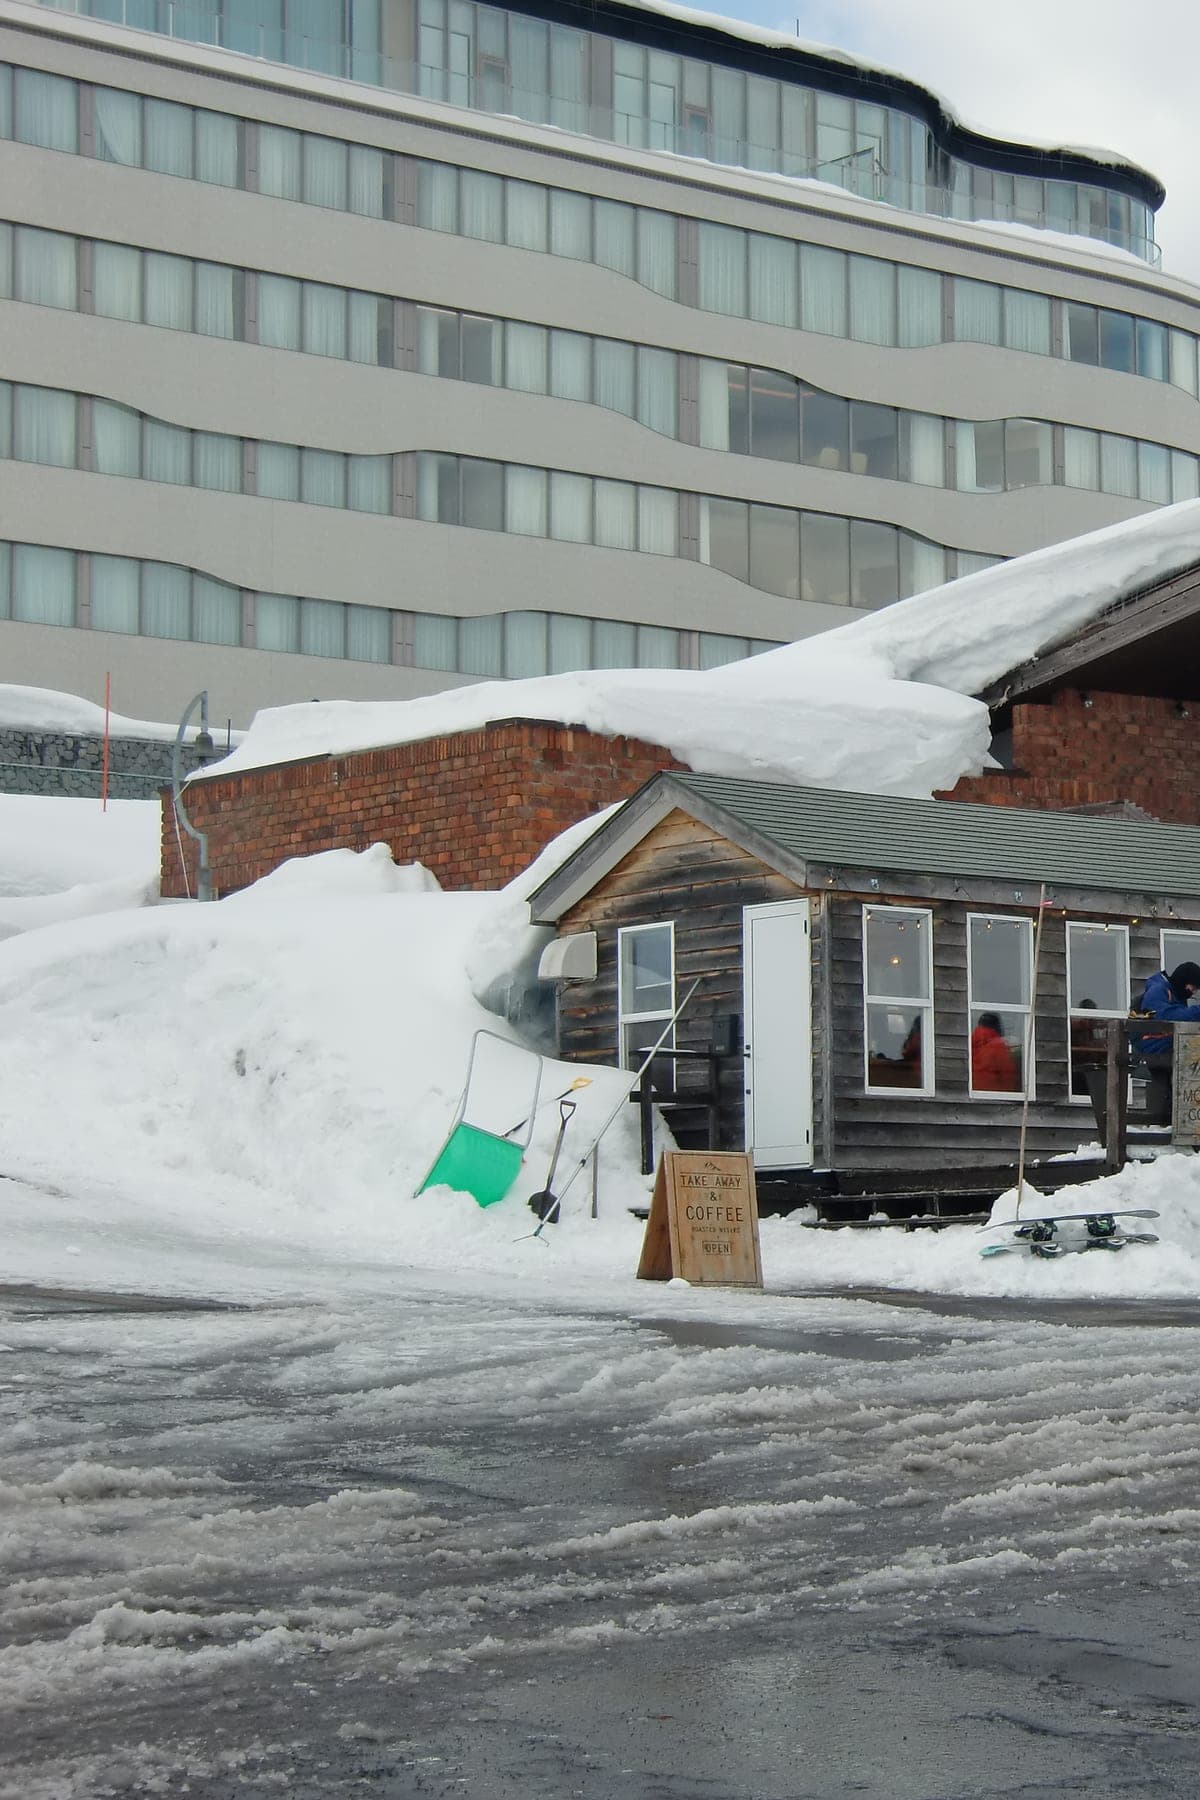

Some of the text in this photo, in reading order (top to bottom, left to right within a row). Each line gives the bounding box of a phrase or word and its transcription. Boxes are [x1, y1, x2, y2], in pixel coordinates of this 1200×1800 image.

[680, 1175, 741, 1187] TAKE AWAY
[710, 1191, 717, 1202] &
[686, 1205, 744, 1222] COFFEE
[704, 1243, 730, 1253] OPEN
